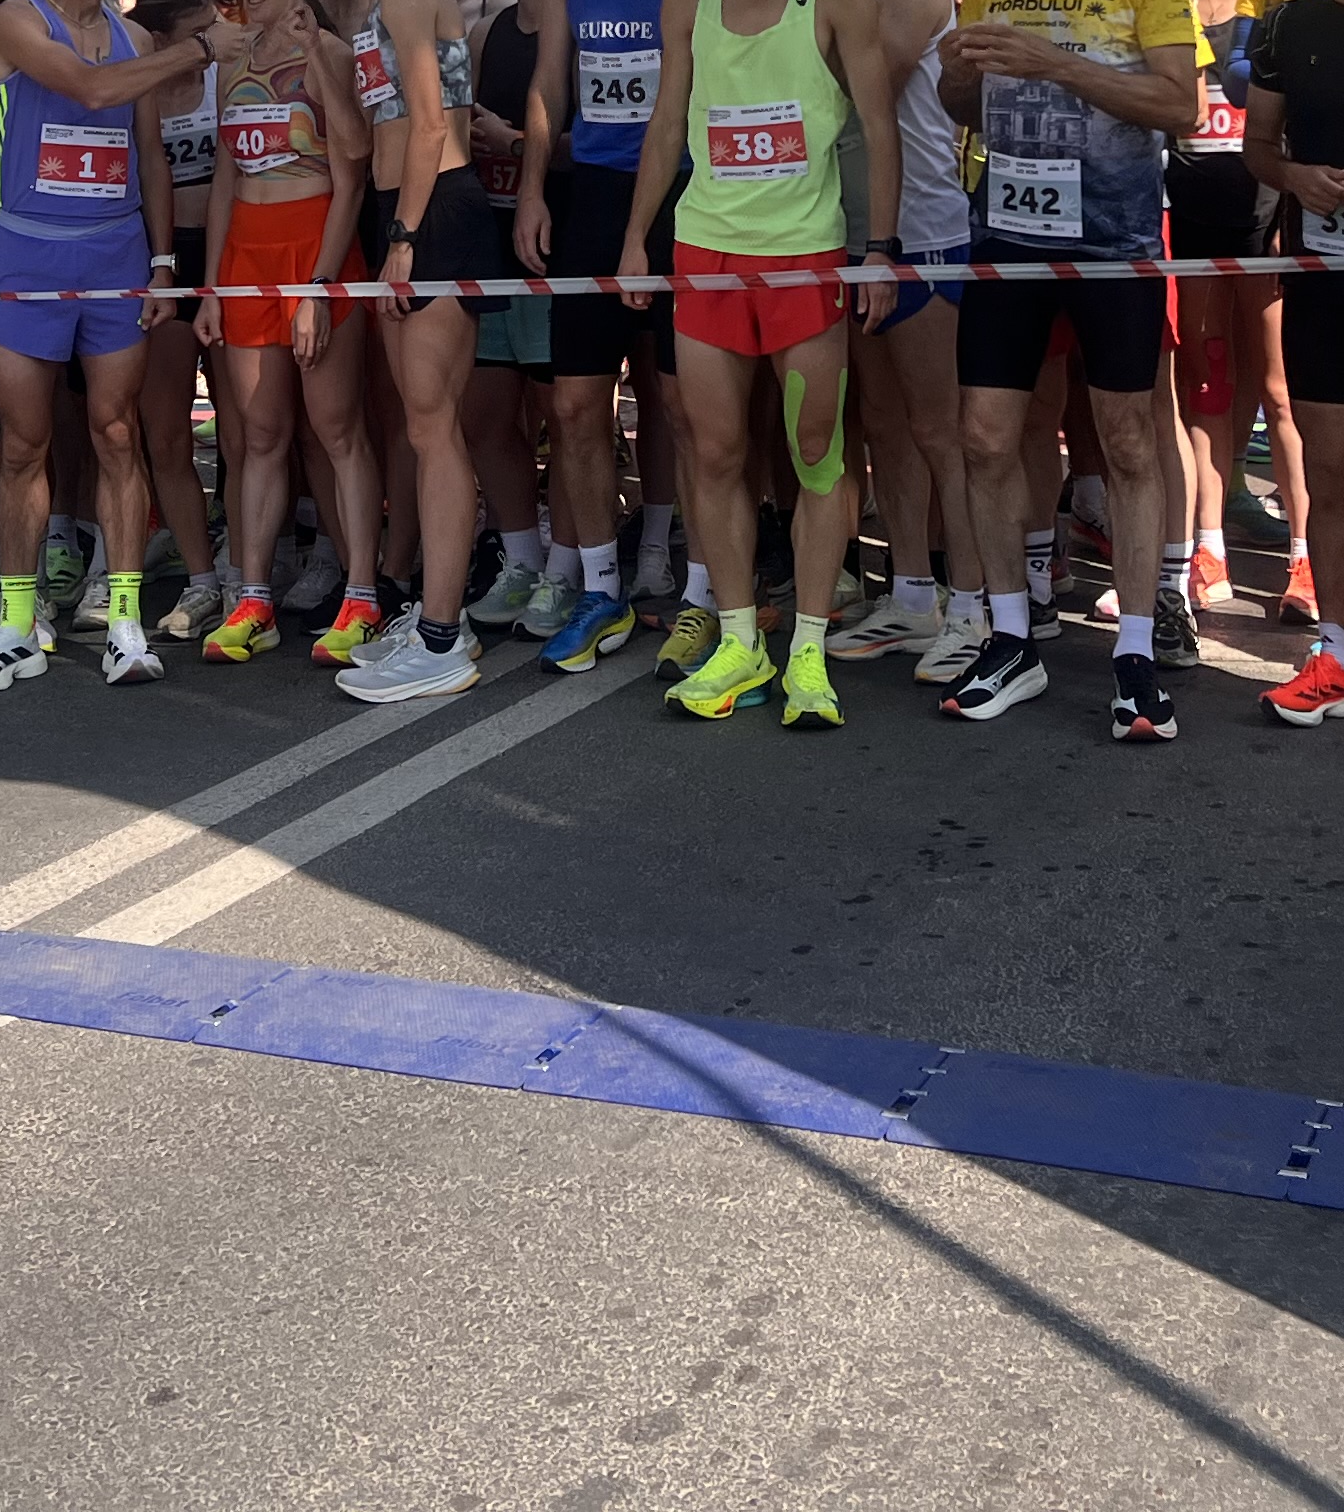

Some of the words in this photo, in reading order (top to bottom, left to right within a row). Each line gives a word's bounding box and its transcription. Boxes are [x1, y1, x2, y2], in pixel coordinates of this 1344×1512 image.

[579, 20, 654, 40] EUROPE
[1013, 19, 1057, 28] powered
[590, 77, 646, 105] 246
[162, 134, 216, 167] 324
[236, 129, 265, 156] 40
[732, 131, 775, 163] 38
[78, 151, 97, 179] 1
[492, 164, 518, 190] 57
[1001, 182, 1061, 216] 242
